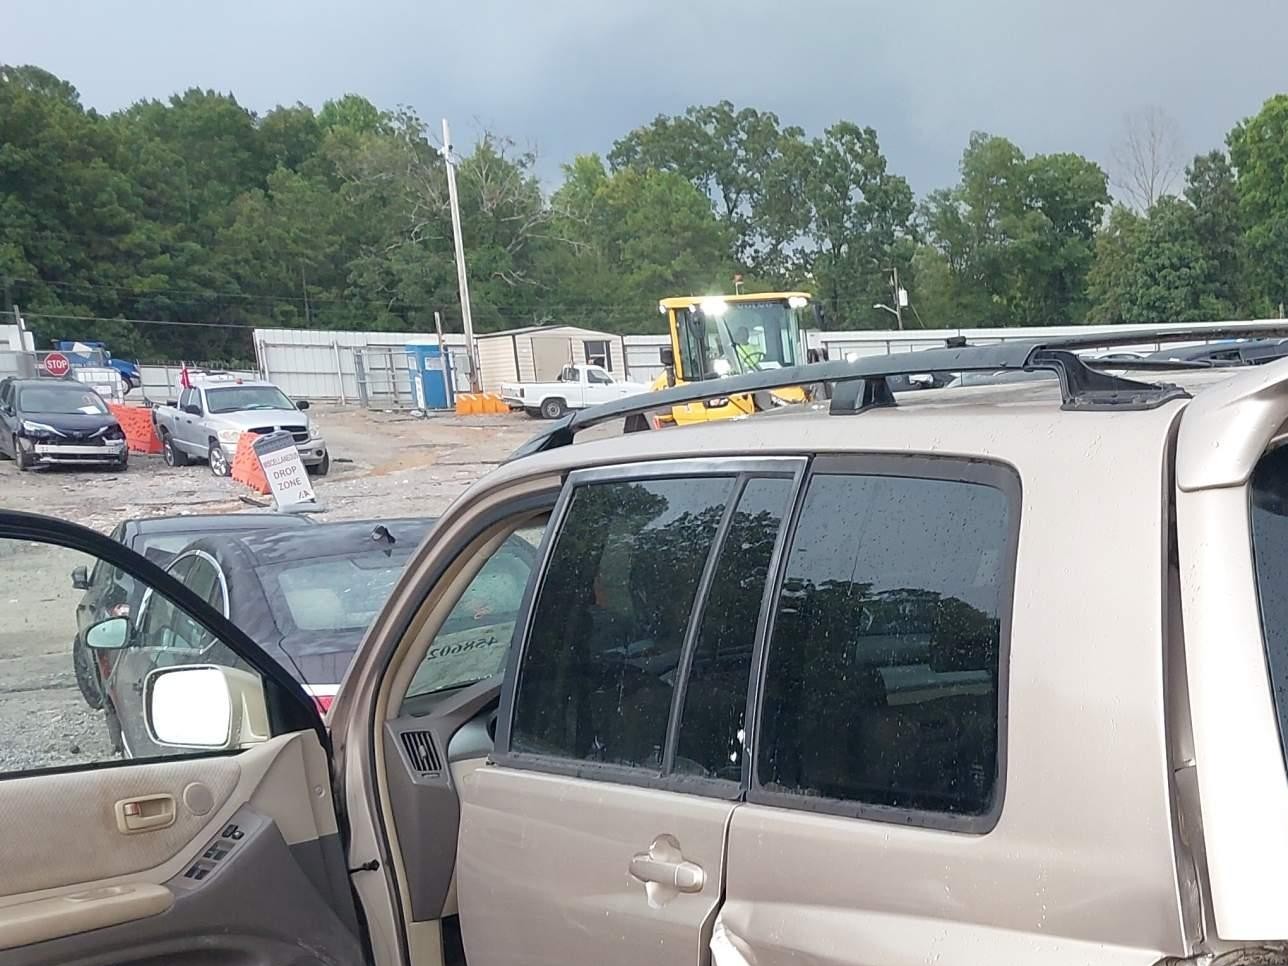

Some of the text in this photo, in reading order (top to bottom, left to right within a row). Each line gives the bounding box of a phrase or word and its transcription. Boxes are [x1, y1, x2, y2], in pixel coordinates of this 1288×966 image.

[47, 359, 67, 369] STOP
[273, 465, 297, 480] DROP
[277, 477, 302, 491] ZONE
